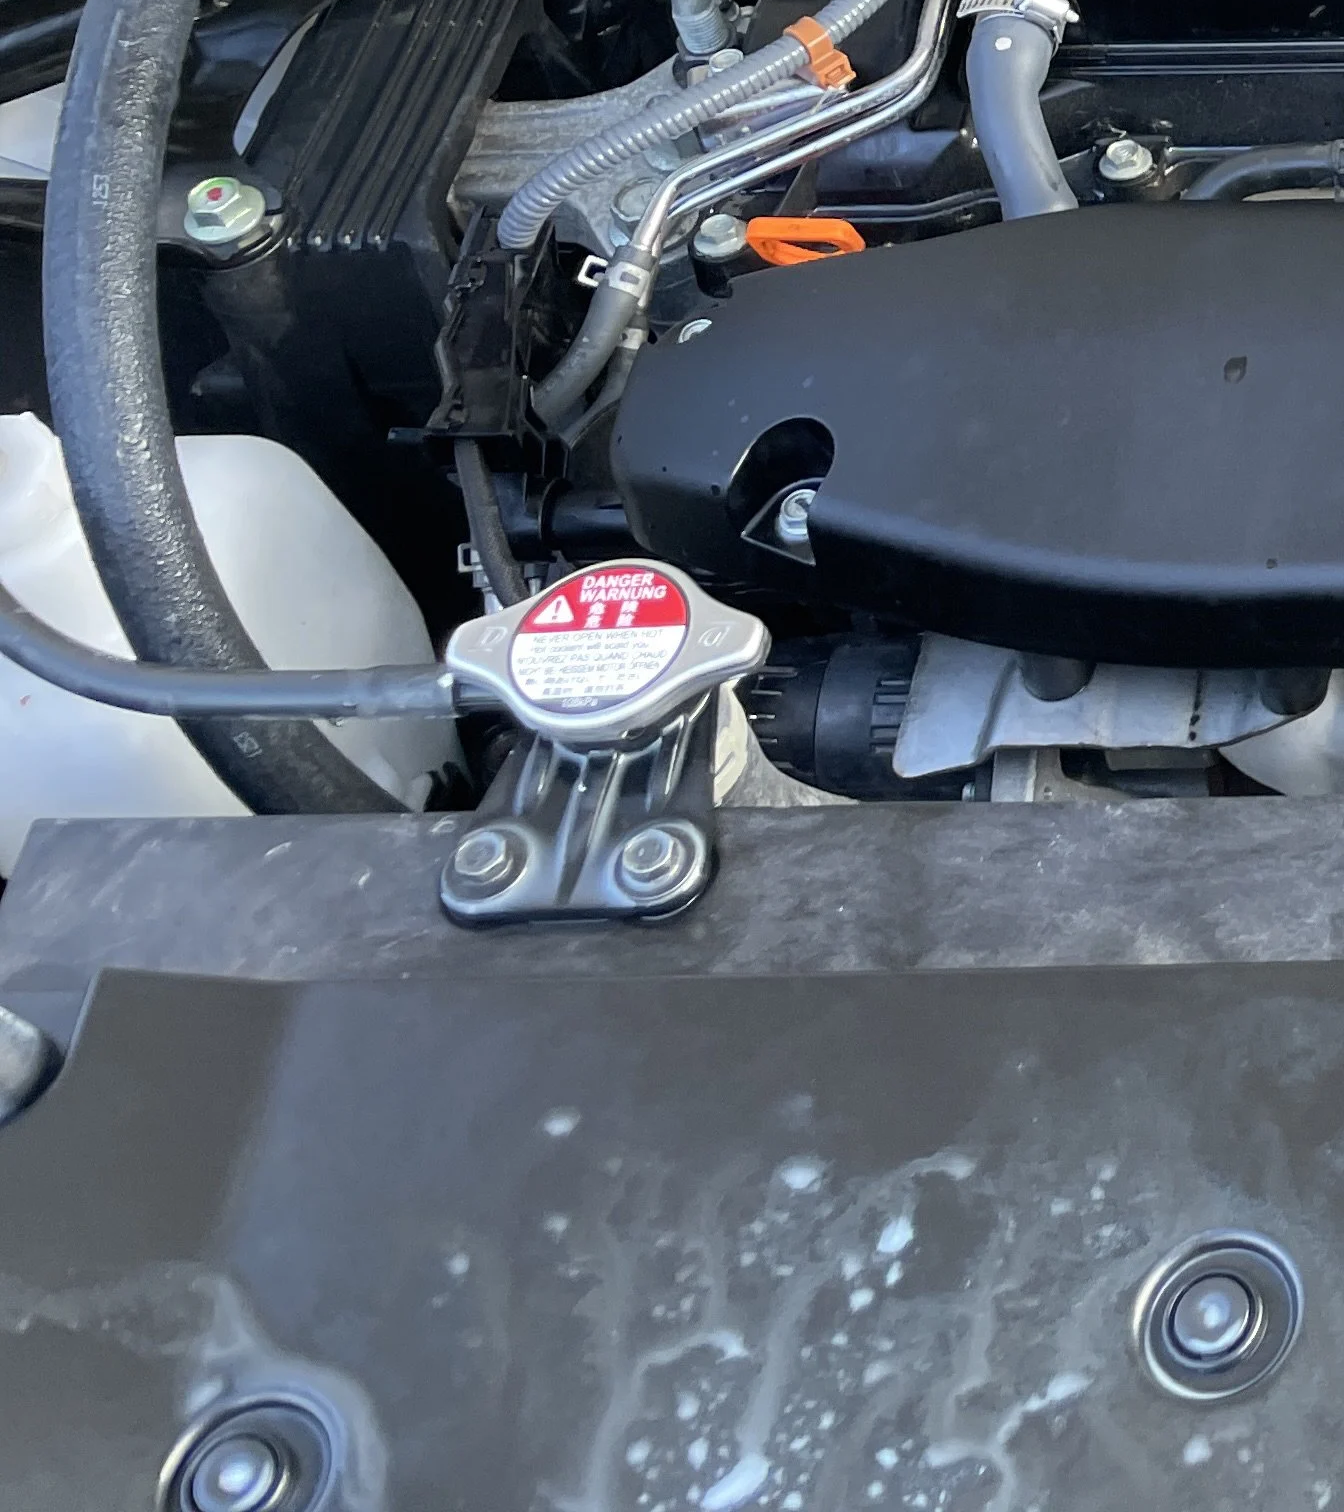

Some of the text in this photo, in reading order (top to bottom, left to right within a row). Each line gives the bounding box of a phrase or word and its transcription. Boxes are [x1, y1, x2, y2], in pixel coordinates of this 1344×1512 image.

[582, 572, 654, 589] DANGER
[579, 585, 668, 602] WARNUNG
[533, 633, 570, 643] NEVER
[572, 631, 603, 641] OPEN
[606, 630, 638, 640] WHEN
